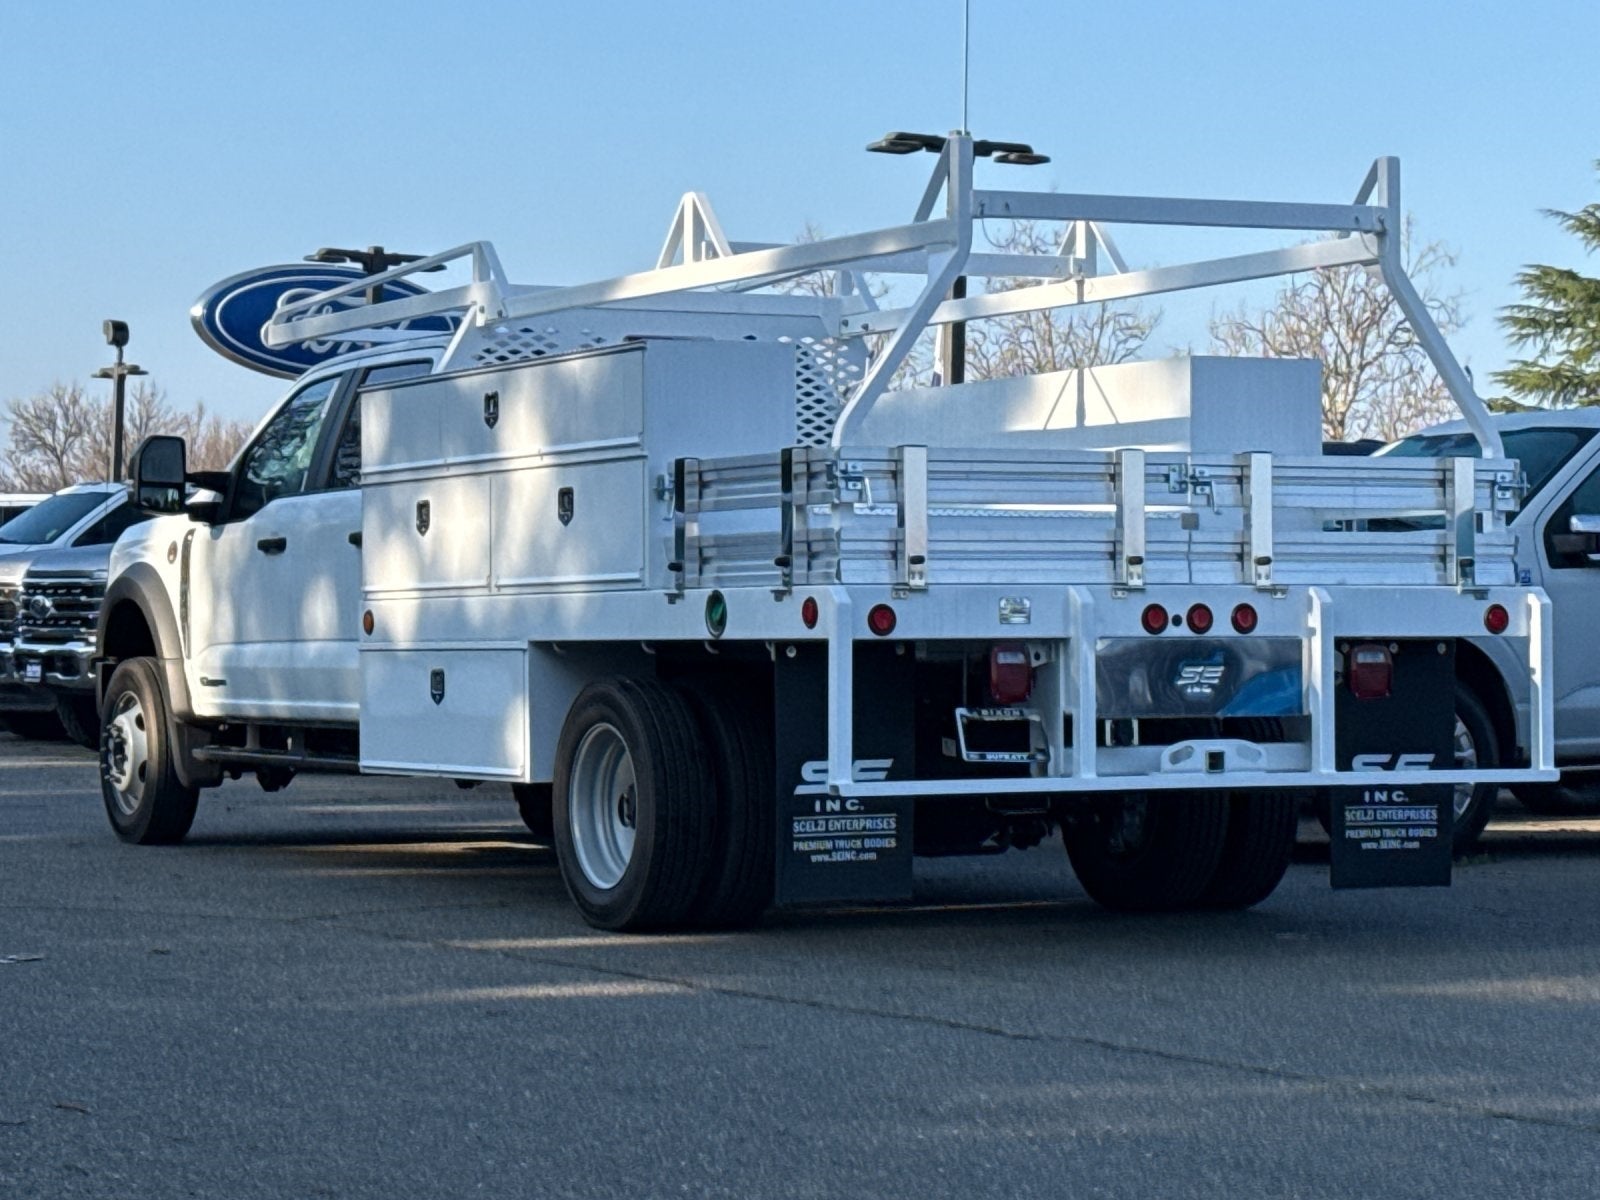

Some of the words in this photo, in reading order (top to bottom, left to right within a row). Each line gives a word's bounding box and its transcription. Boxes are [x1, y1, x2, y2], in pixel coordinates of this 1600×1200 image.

[1176, 666, 1225, 685] SE
[1364, 790, 1409, 803] INC.
[815, 799, 864, 812] INC.
[1376, 808, 1438, 820] ENTERPRISES
[793, 820, 826, 833] SCELZI
[828, 817, 897, 831] ENTERPRISES
[1382, 828, 1407, 838] TRUCK
[793, 840, 833, 851] PREMIUM
[834, 839, 863, 849] TRUCK
[863, 837, 897, 849] BODIES
